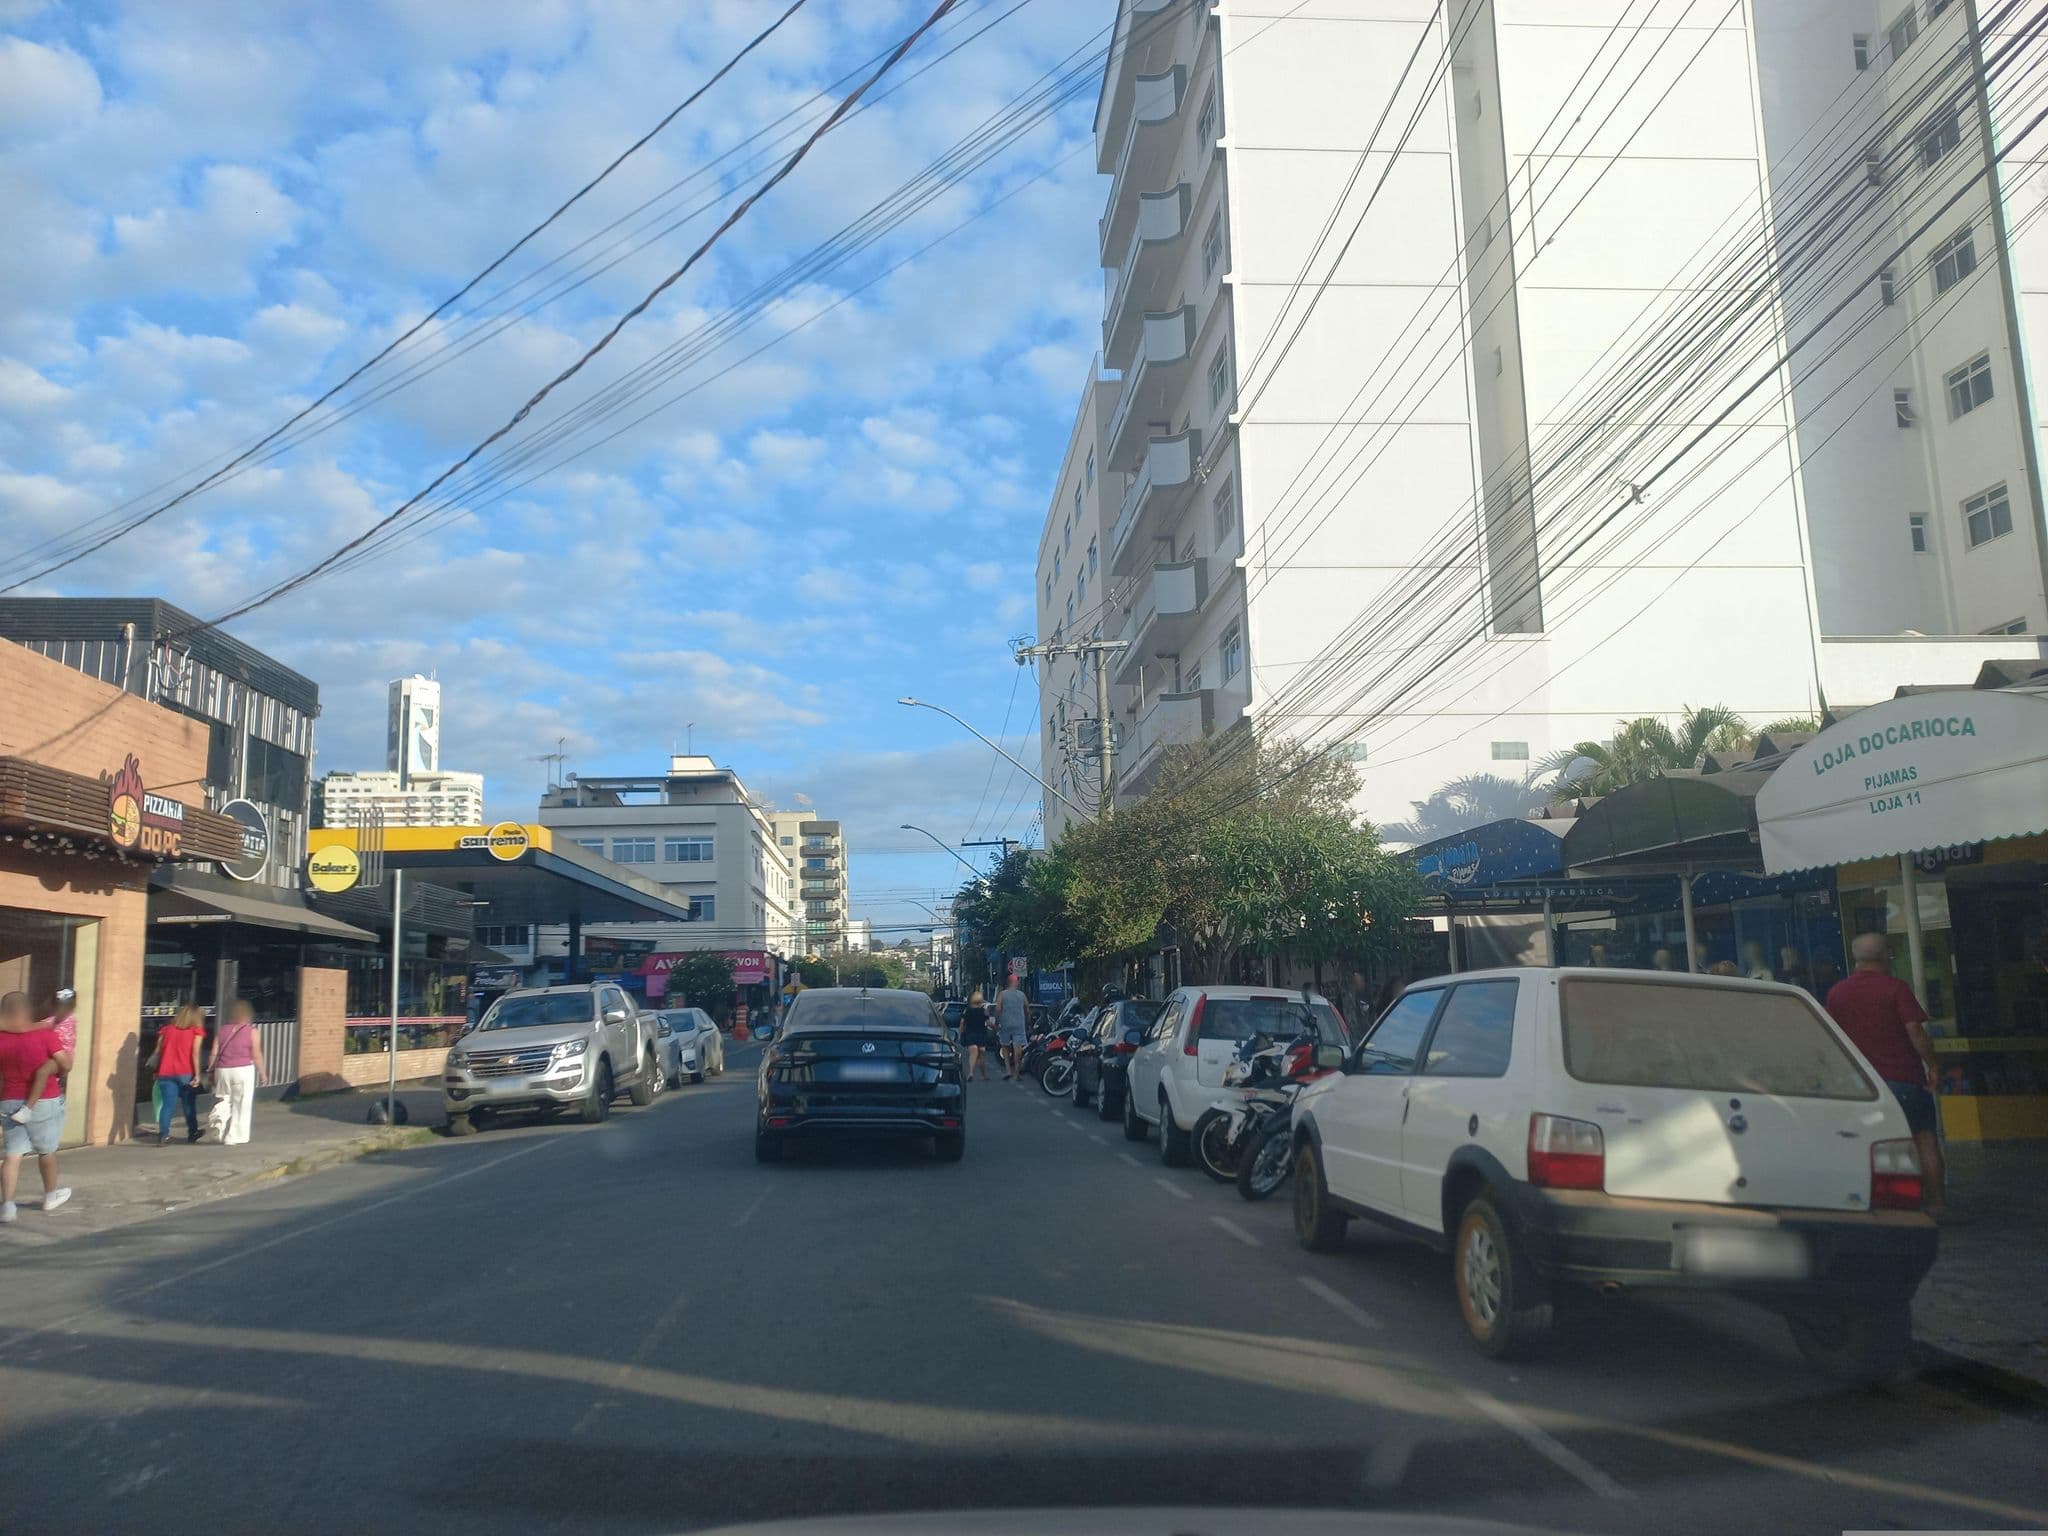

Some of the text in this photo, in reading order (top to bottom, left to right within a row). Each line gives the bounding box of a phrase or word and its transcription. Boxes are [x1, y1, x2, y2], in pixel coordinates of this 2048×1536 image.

[1813, 717, 1976, 775] LOJA DO CARIOCA
[1864, 766, 1918, 790] PIJAMAS
[143, 794, 183, 821] PIZZARIA
[1869, 791, 1921, 814] LOJA 11
[312, 862, 357, 873] Baker's
